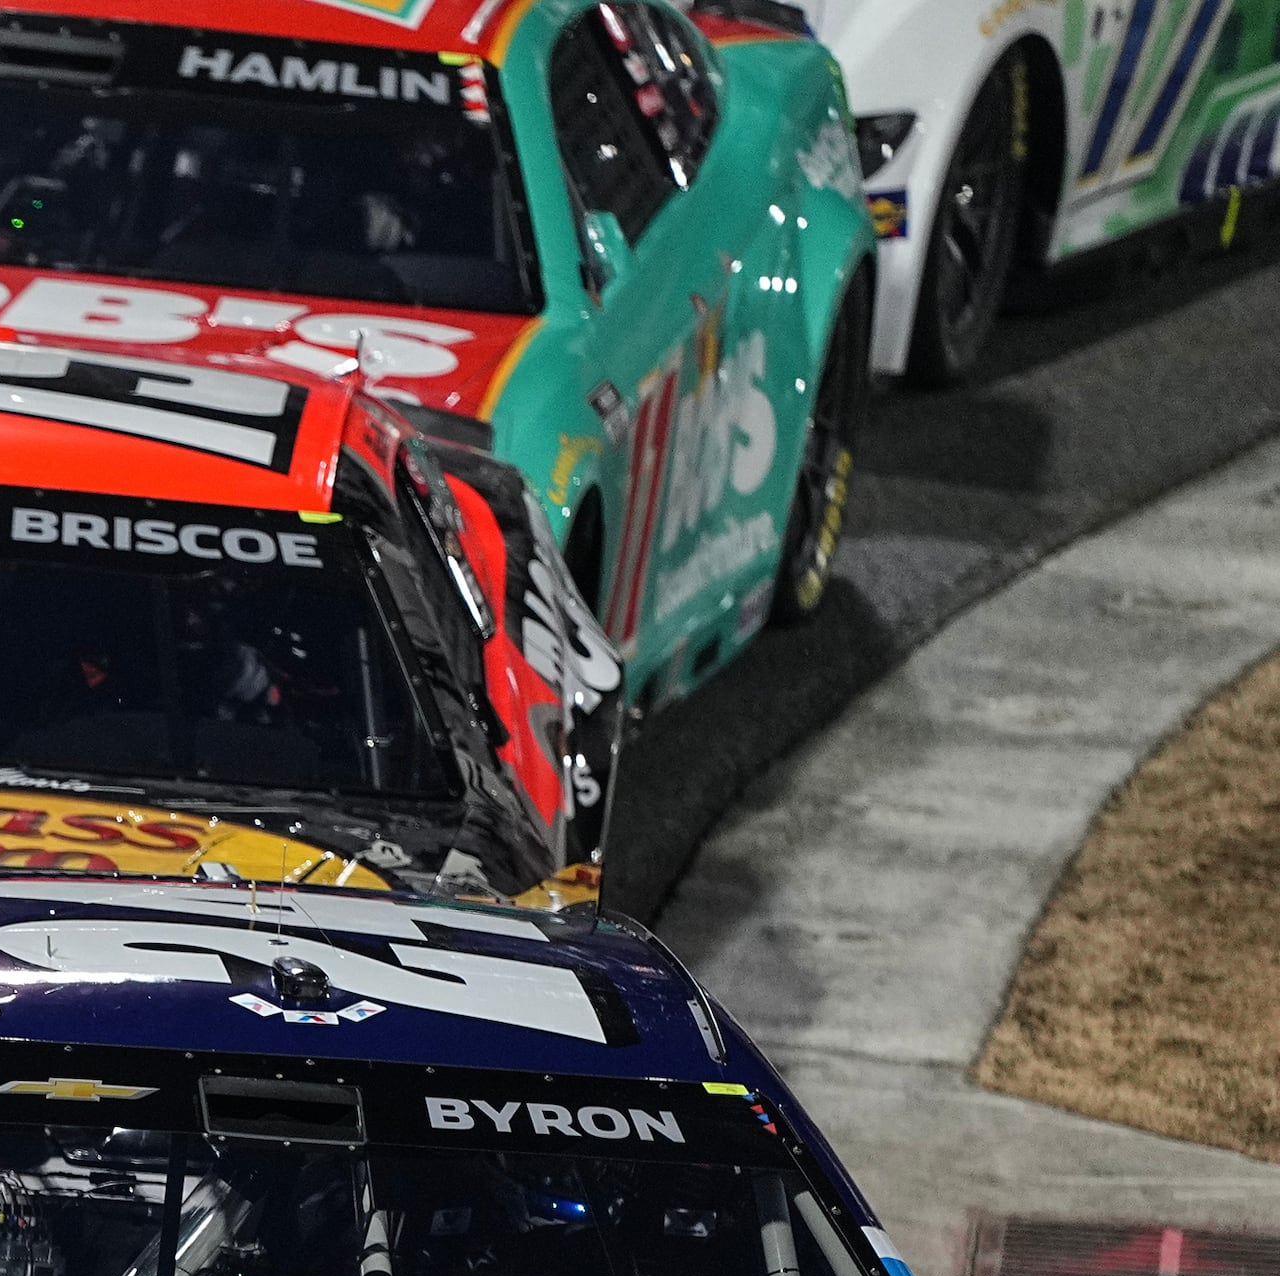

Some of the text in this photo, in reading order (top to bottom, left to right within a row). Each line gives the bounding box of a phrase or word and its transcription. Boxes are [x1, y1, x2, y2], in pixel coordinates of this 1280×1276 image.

[178, 46, 450, 105] HAMLIN
[10, 506, 324, 569] BRISCOE
[424, 1096, 685, 1144] BYRON
